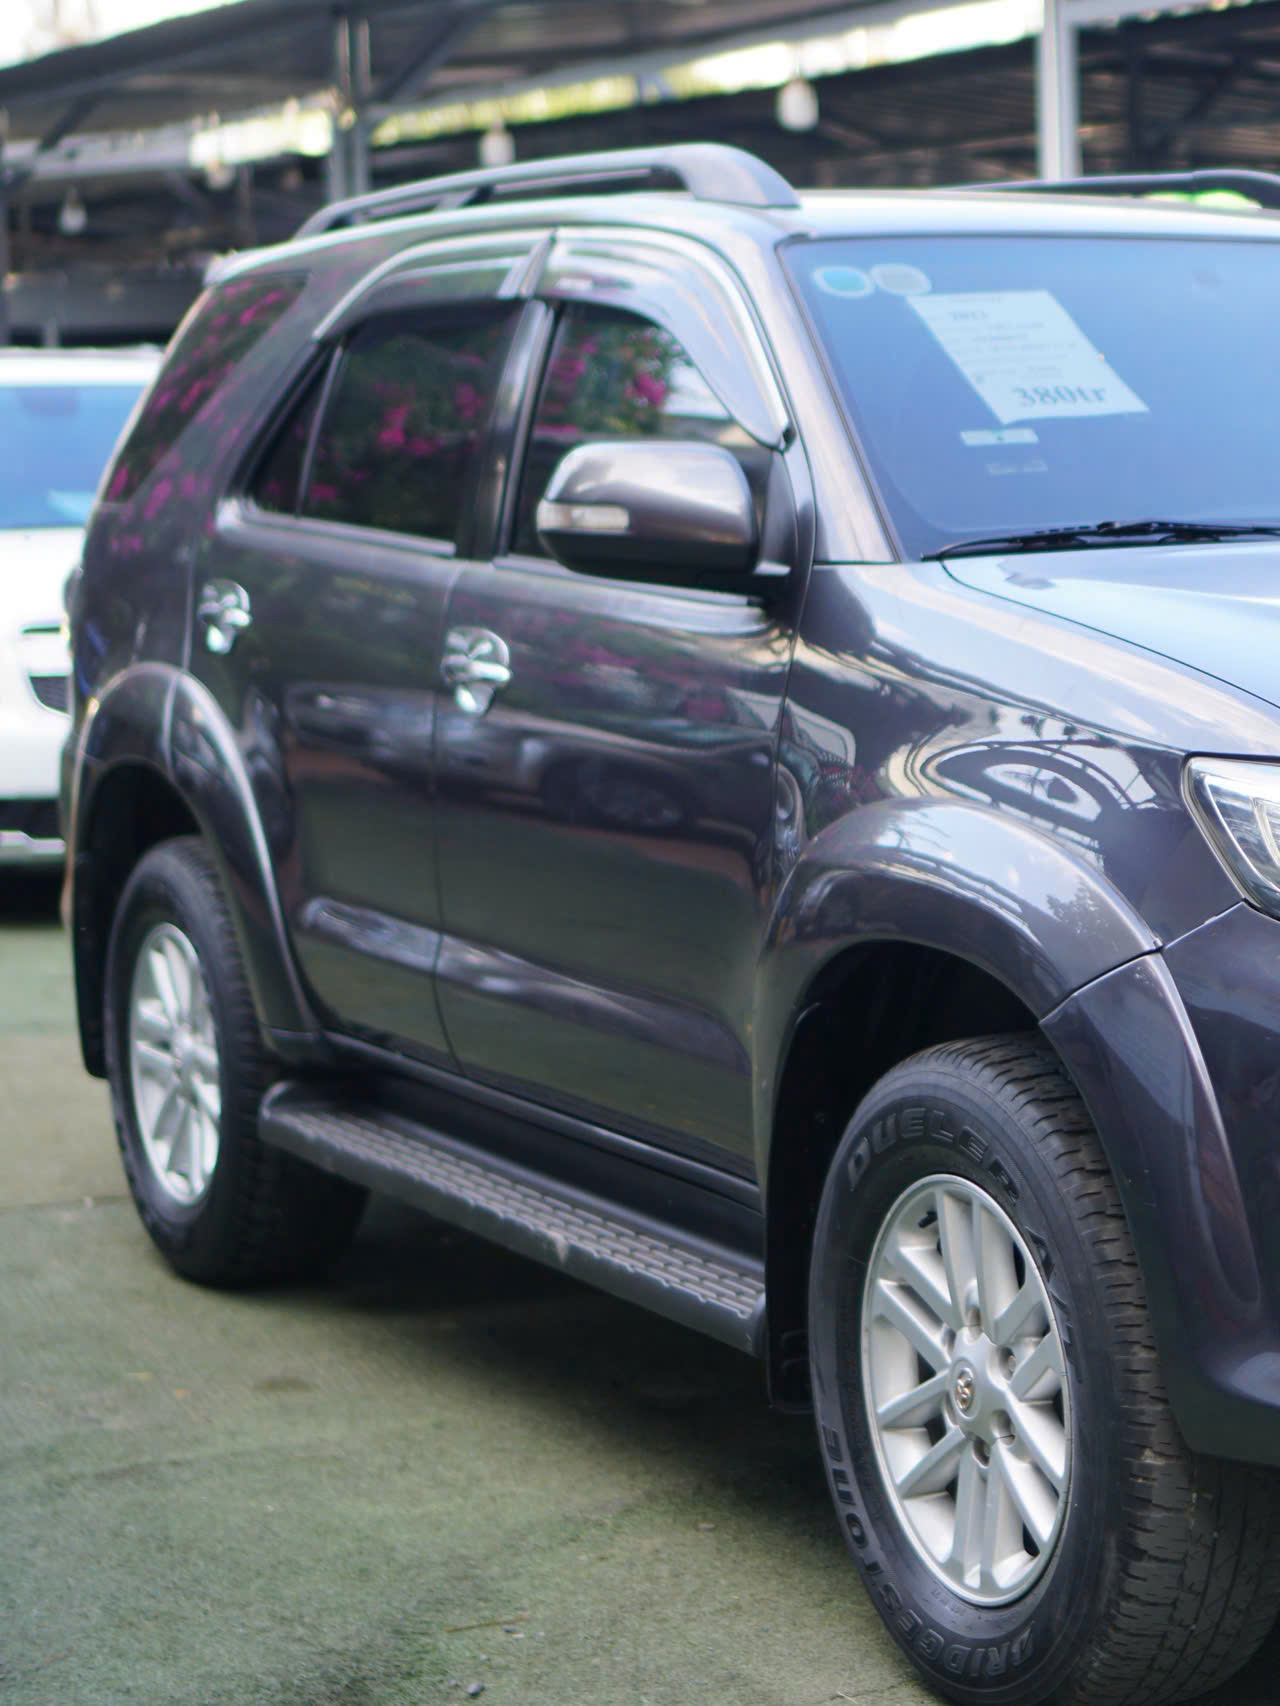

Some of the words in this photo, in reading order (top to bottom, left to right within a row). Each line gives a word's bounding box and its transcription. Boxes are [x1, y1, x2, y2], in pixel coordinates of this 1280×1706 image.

[1011, 384, 1108, 408] 380tr
[847, 1105, 1021, 1201] DUELER
[821, 1422, 1037, 1678] BRIDGESTONE
